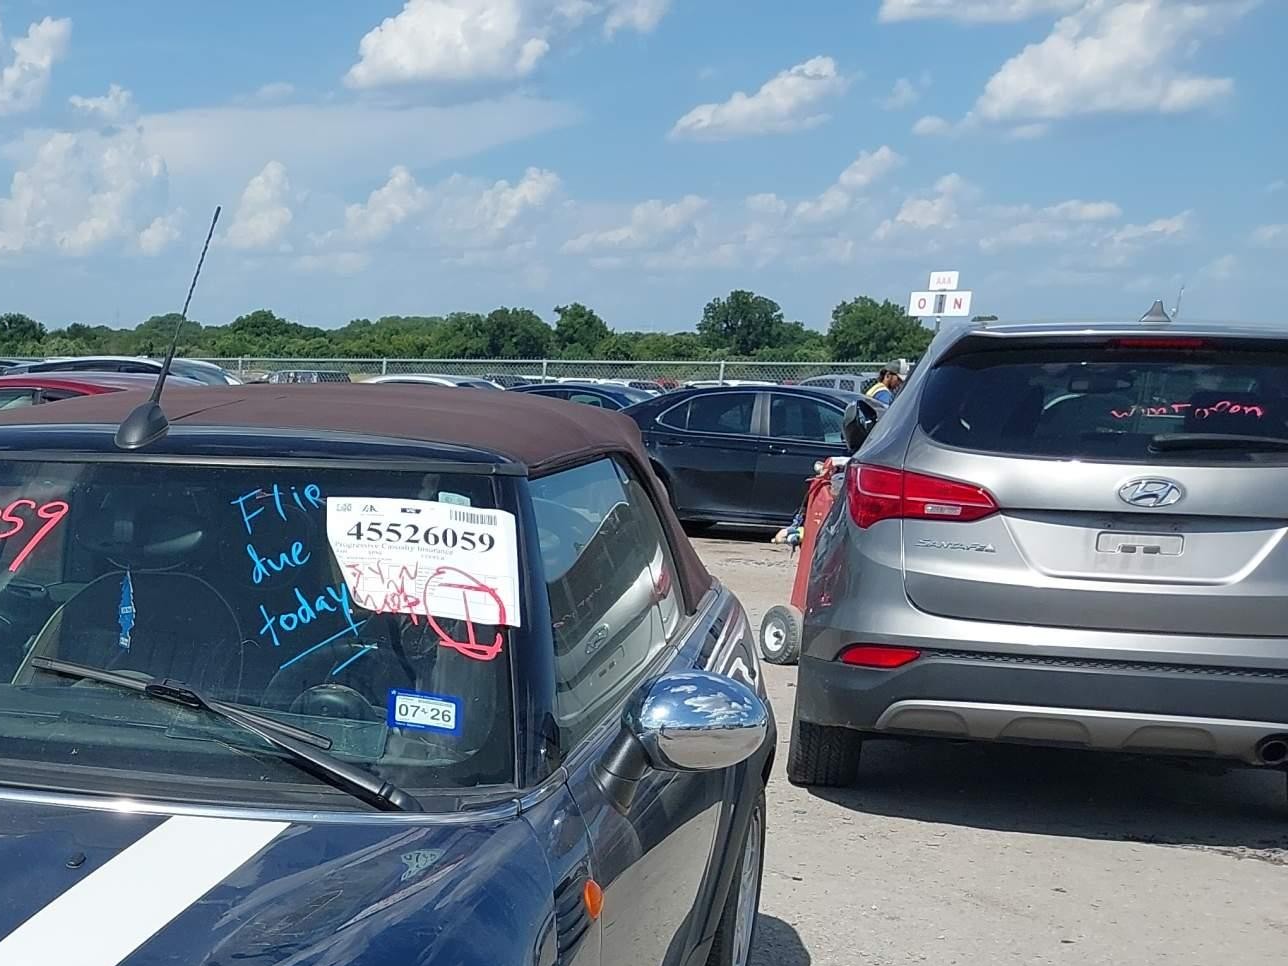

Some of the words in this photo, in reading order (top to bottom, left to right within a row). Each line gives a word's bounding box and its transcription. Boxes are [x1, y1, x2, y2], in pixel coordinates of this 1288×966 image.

[953, 297, 963, 310] N
[335, 541, 379, 550] Progressive
[417, 546, 454, 555] Insurance
[346, 520, 496, 553] 45526059
[246, 541, 312, 585] due
